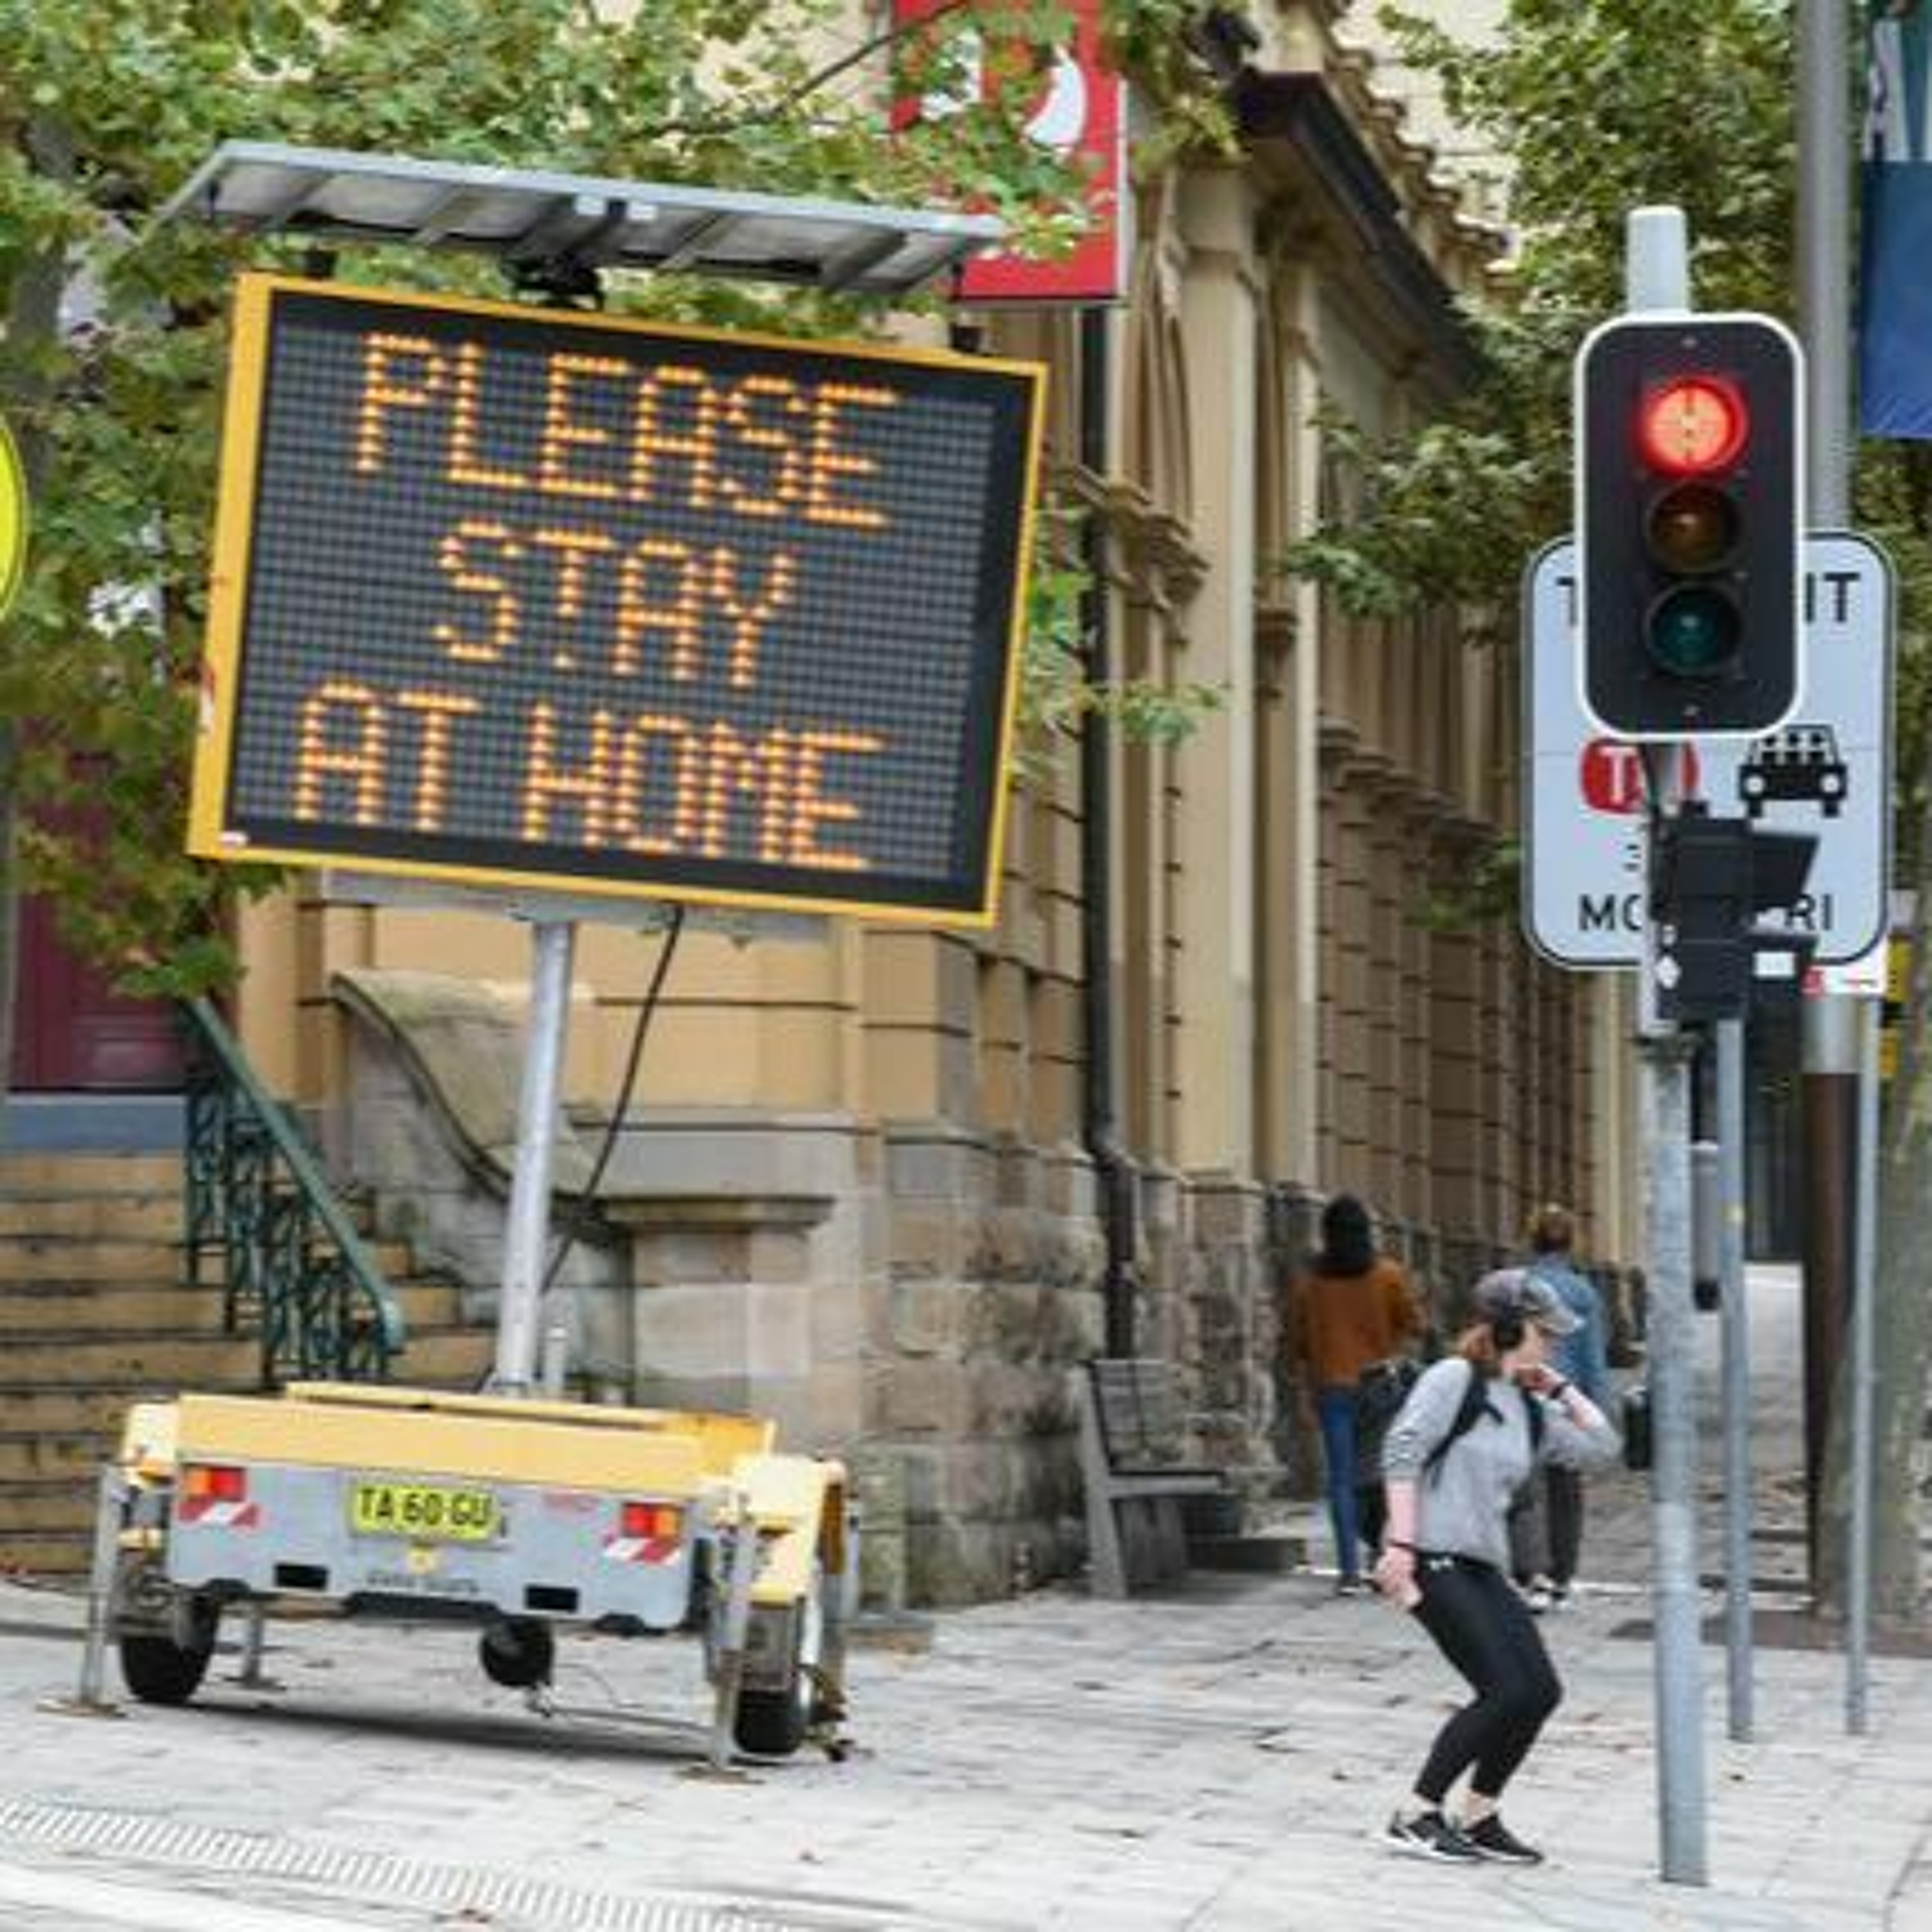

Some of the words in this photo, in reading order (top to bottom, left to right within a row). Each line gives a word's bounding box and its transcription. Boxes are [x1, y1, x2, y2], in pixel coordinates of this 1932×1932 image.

[354, 332, 899, 527] PLEASE
[433, 519, 800, 687] STAY
[293, 679, 483, 832] AT
[520, 703, 885, 869] HOME
